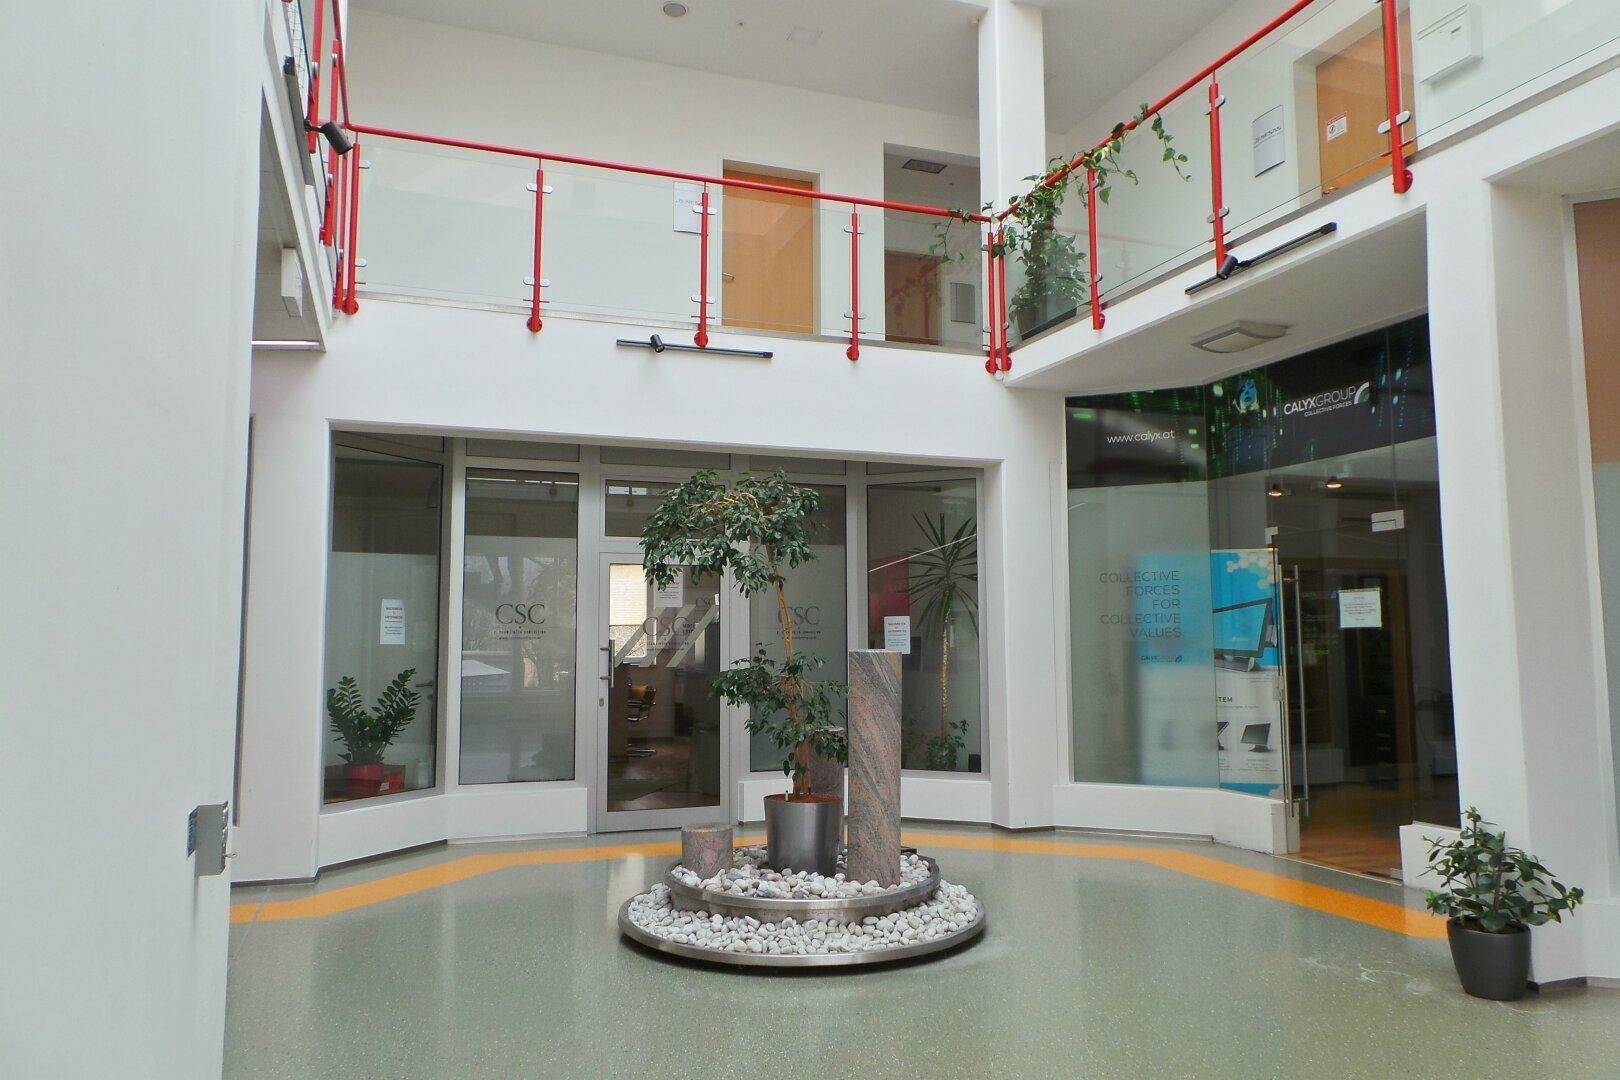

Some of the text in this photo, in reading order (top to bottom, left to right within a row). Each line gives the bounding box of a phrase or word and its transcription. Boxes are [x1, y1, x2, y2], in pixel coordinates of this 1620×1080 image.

[1284, 386, 1356, 415] CALYXGROUP
[1304, 400, 1352, 417] COLLECTIVE FORCES
[1106, 430, 1175, 444] www.calyx.at
[1099, 570, 1180, 583] COLLECTIVE
[1126, 584, 1180, 596] FORCES
[1152, 598, 1181, 610] FOR
[495, 603, 546, 625] CSC
[1099, 612, 1182, 625] COLLECTIVE
[1128, 627, 1182, 638] VALUES
